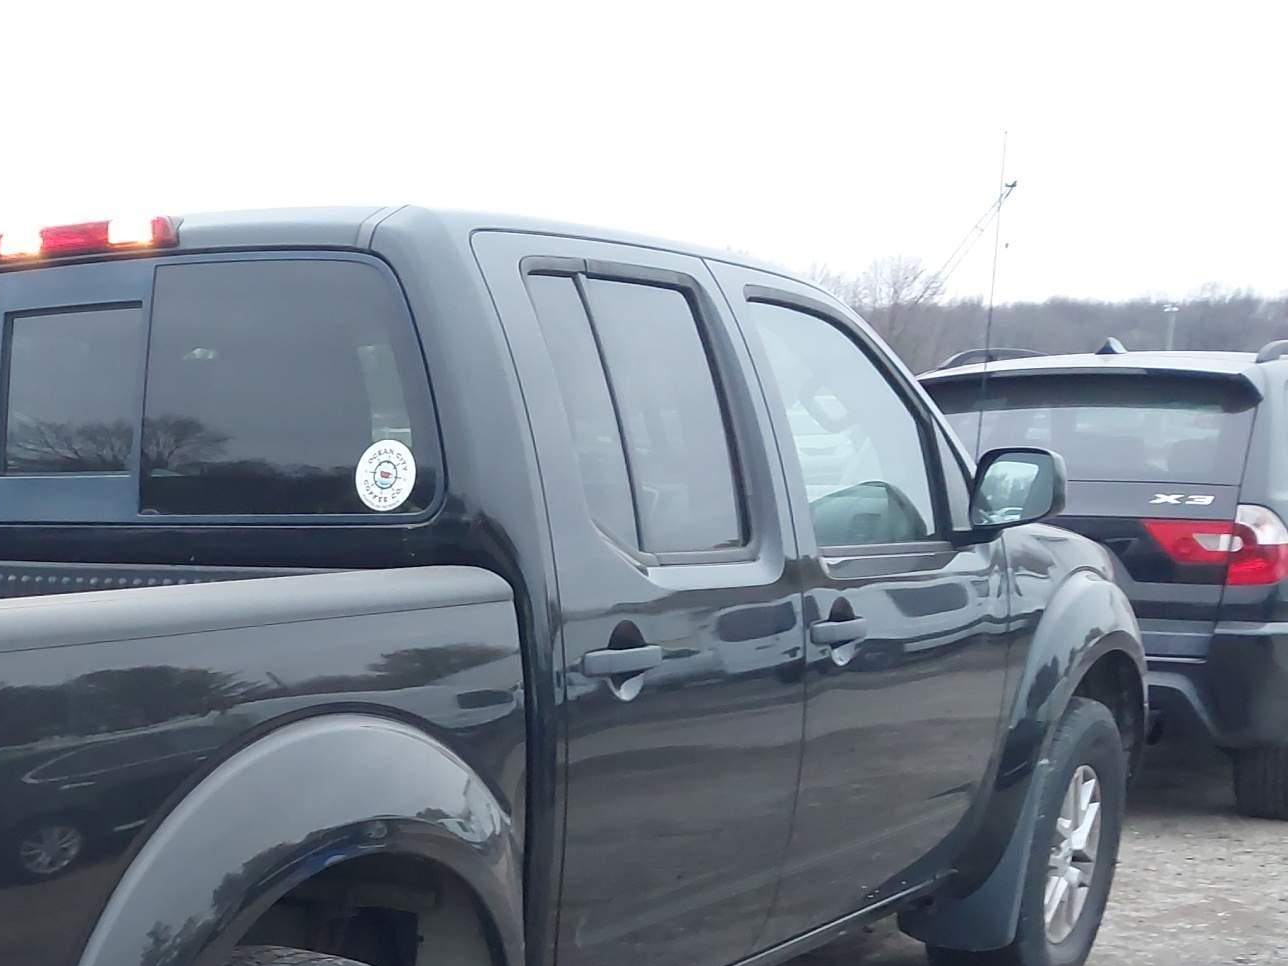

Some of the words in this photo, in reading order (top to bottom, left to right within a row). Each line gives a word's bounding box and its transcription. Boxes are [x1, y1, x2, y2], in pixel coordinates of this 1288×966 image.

[368, 448, 394, 464] OCEAN
[396, 452, 408, 471] CITY
[364, 479, 388, 503] COFFEE
[1148, 493, 1215, 505] X3
